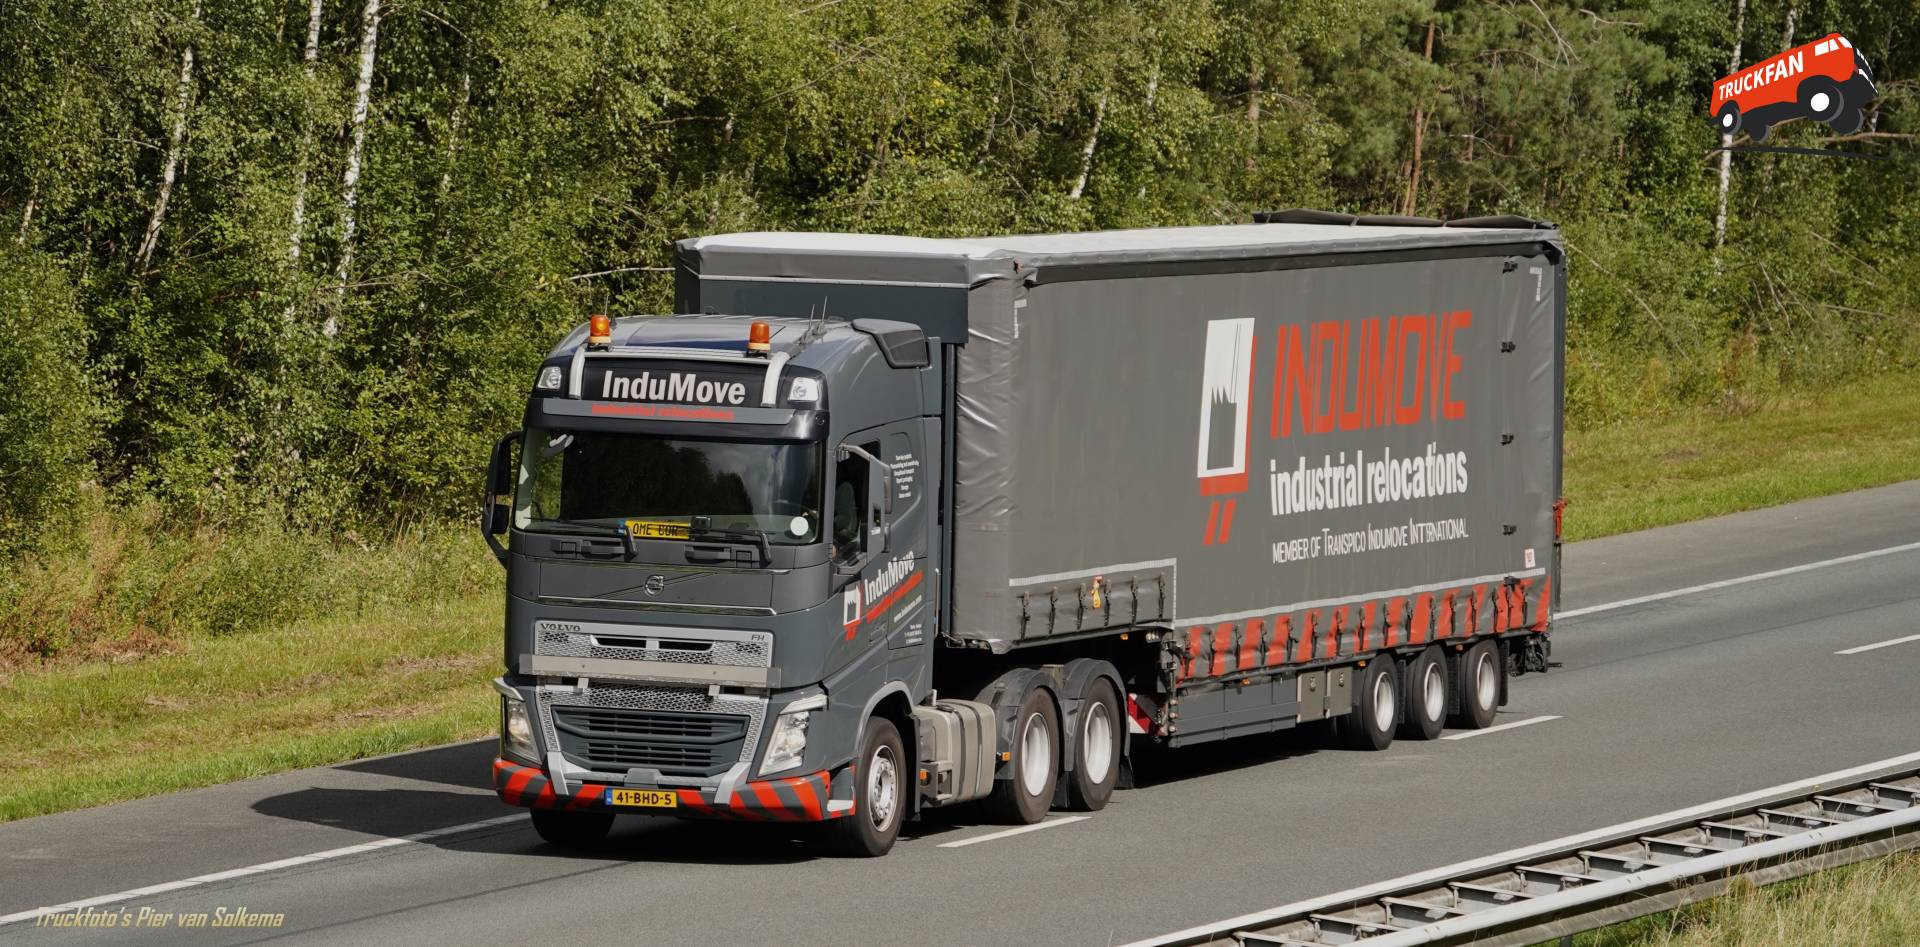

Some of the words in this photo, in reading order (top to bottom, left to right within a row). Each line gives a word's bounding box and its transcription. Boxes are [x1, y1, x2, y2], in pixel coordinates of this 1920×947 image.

[602, 369, 747, 405] InduMove
[1270, 310, 1472, 440] INDUMOVE
[1270, 450, 1363, 516] industrial
[1366, 441, 1468, 504] relocations
[632, 523, 652, 536] OME
[1272, 538, 1309, 564] MEMBER
[1310, 536, 1322, 558] OF
[864, 550, 915, 606] InduMove
[540, 623, 582, 632] VOLVO
[616, 792, 672, 805] 41-BHD-5
